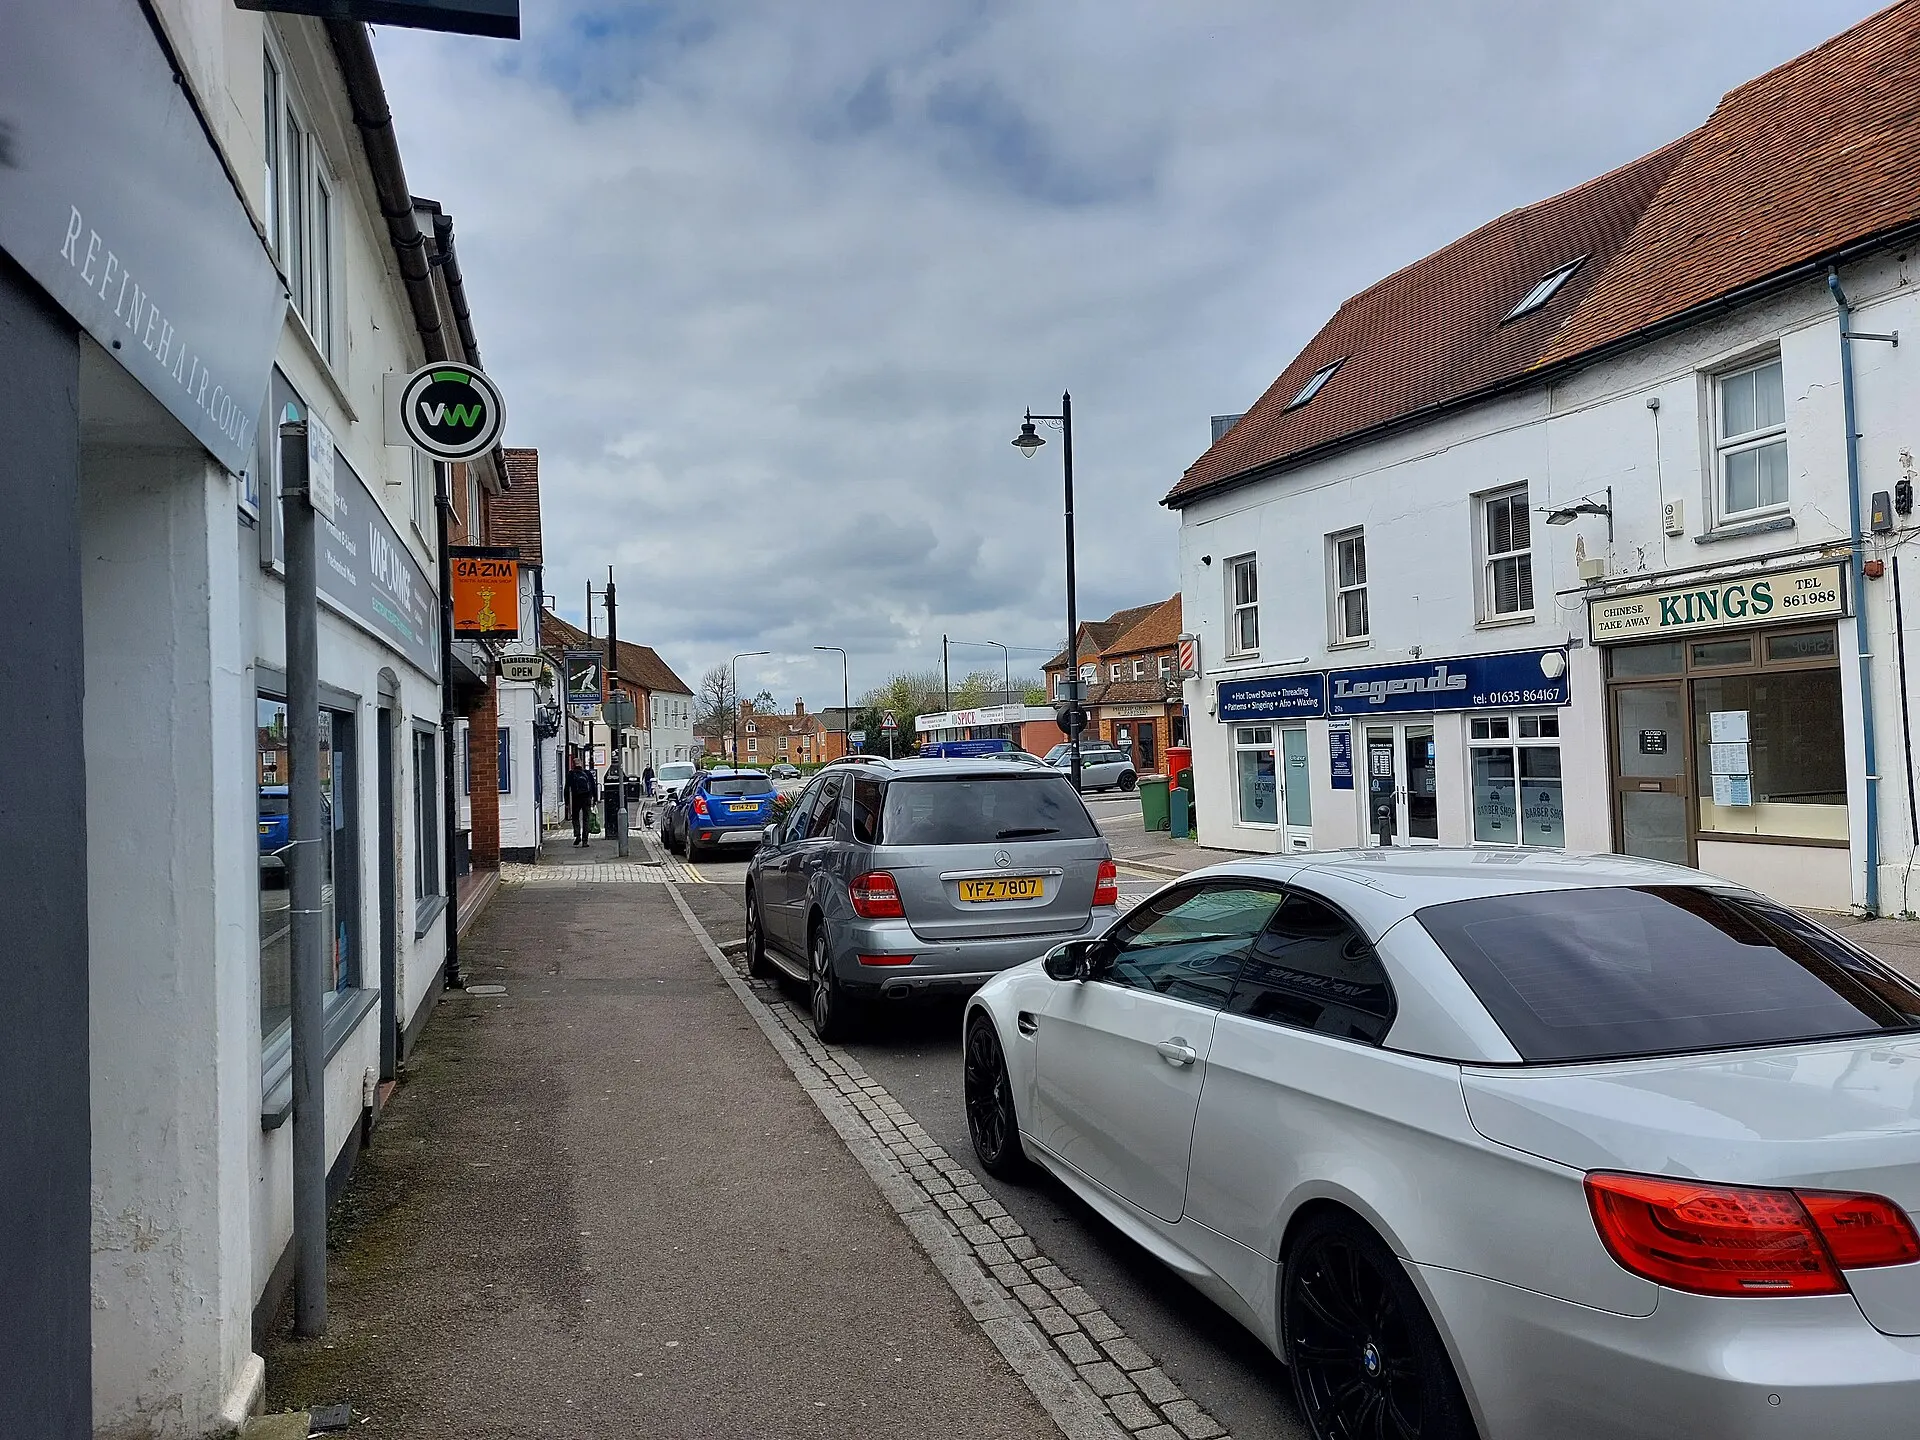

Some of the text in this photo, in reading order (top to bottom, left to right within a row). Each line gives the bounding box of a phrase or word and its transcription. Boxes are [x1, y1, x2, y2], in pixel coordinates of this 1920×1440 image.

[457, 561, 513, 577] SA-ZIM
[1795, 577, 1822, 590] TEL
[1658, 581, 1774, 627] KINGS
[1783, 590, 1836, 608] 861988
[1603, 604, 1644, 617] CHINESE
[1598, 616, 1651, 630] TAKE AWAY
[502, 656, 542, 664] BARBERSHOP
[511, 667, 533, 677] OPEN
[1333, 666, 1467, 704] Legends
[1235, 687, 1309, 700] Hot Towel Shave Threading
[1473, 689, 1560, 705] tel: 01635 864167
[1228, 703, 1247, 711] Patterns
[1296, 698, 1319, 708] Waxing
[1525, 806, 1549, 819] BARBER
[965, 880, 1037, 898] YFZ 7807
